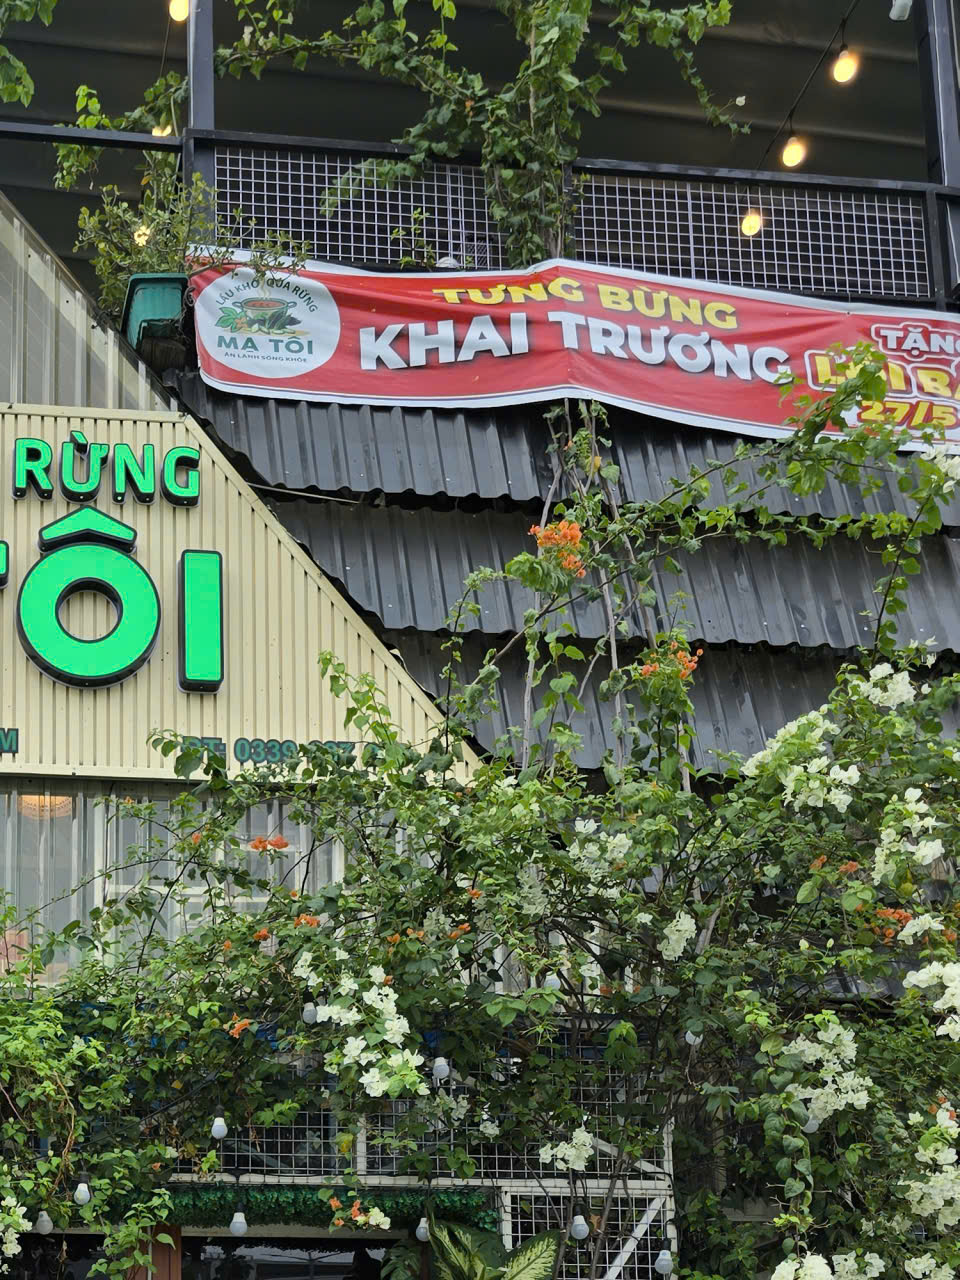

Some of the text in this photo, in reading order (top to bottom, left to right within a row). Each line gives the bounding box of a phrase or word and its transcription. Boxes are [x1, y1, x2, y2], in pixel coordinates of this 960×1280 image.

[266, 278, 290, 291] QUA
[432, 277, 584, 305] TƯNG
[217, 335, 313, 355] MẠ TÔI
[359, 311, 794, 385] KHAI TRƯƠNG
[880, 327, 960, 356] TẶN
[861, 400, 957, 427] 27/5
[13, 430, 201, 506] RỪNG
